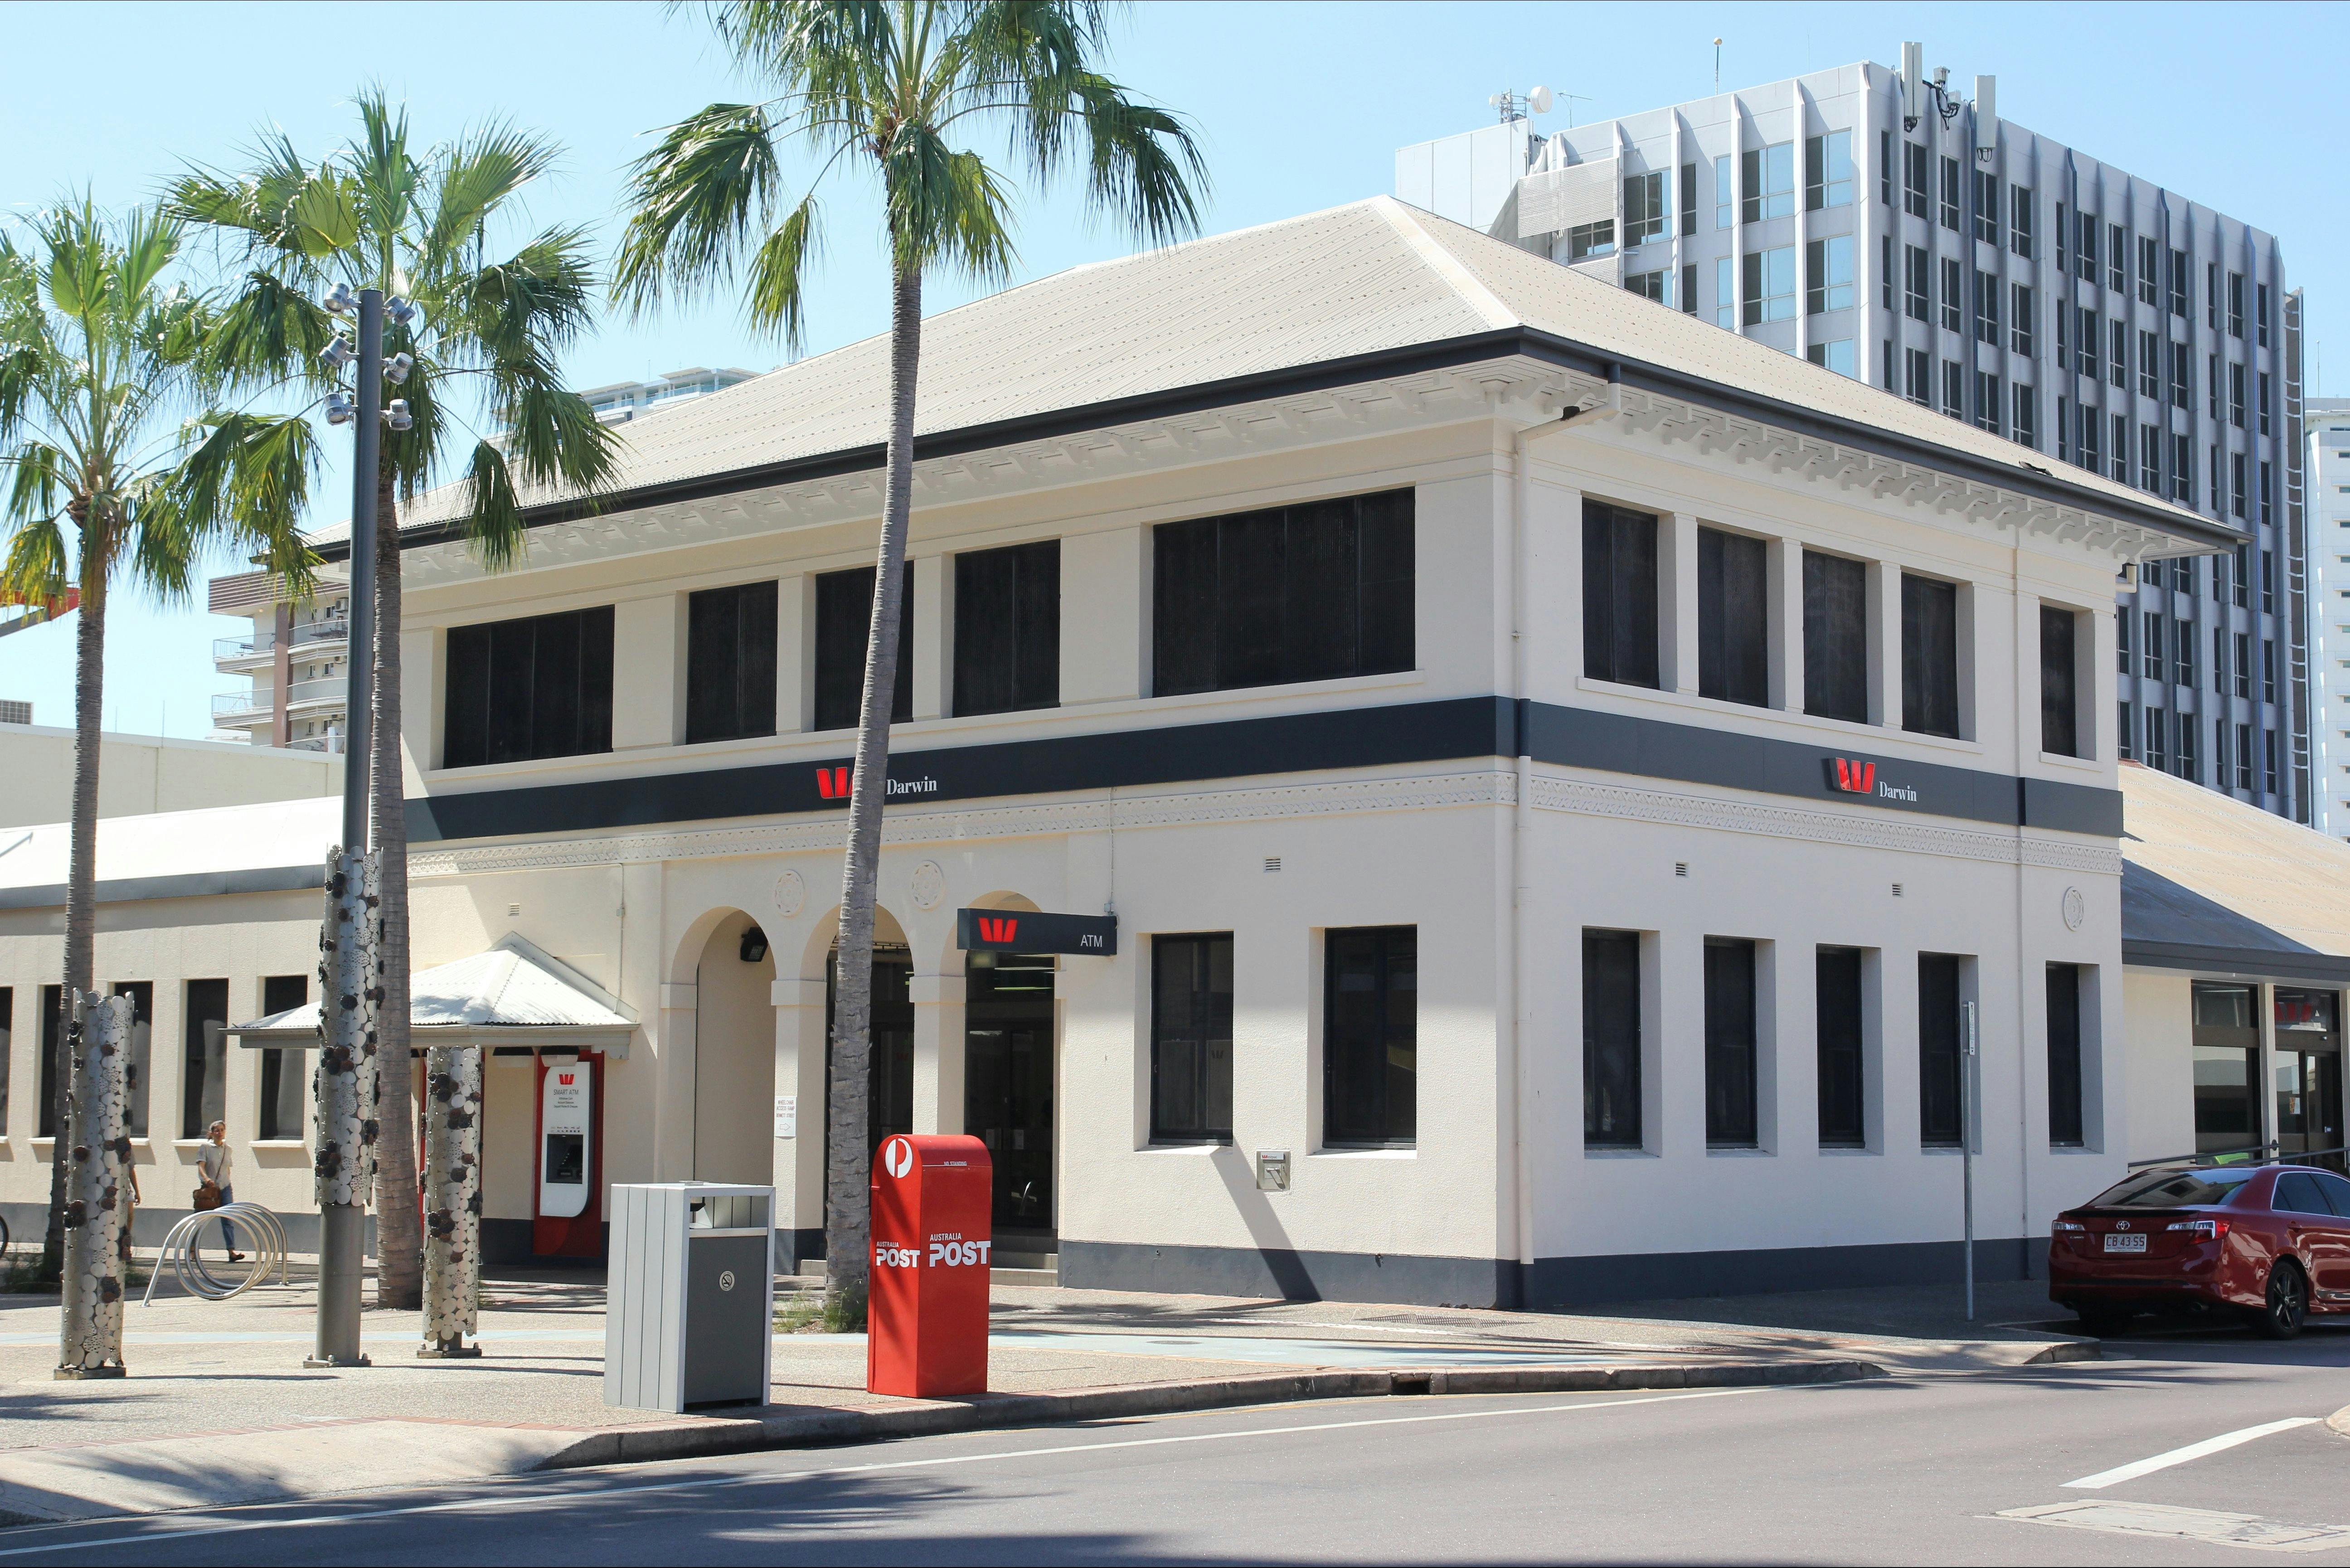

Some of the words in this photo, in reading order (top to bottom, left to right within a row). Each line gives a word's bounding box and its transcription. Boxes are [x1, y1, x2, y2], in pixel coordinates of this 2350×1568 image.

[886, 776, 937, 795] Darwin
[1879, 781, 1917, 802] Darwin
[1080, 934, 1102, 947] ATM
[930, 1233, 961, 1241] AUSTRALIA
[876, 1248, 920, 1267] POST
[929, 1241, 991, 1267] POST
